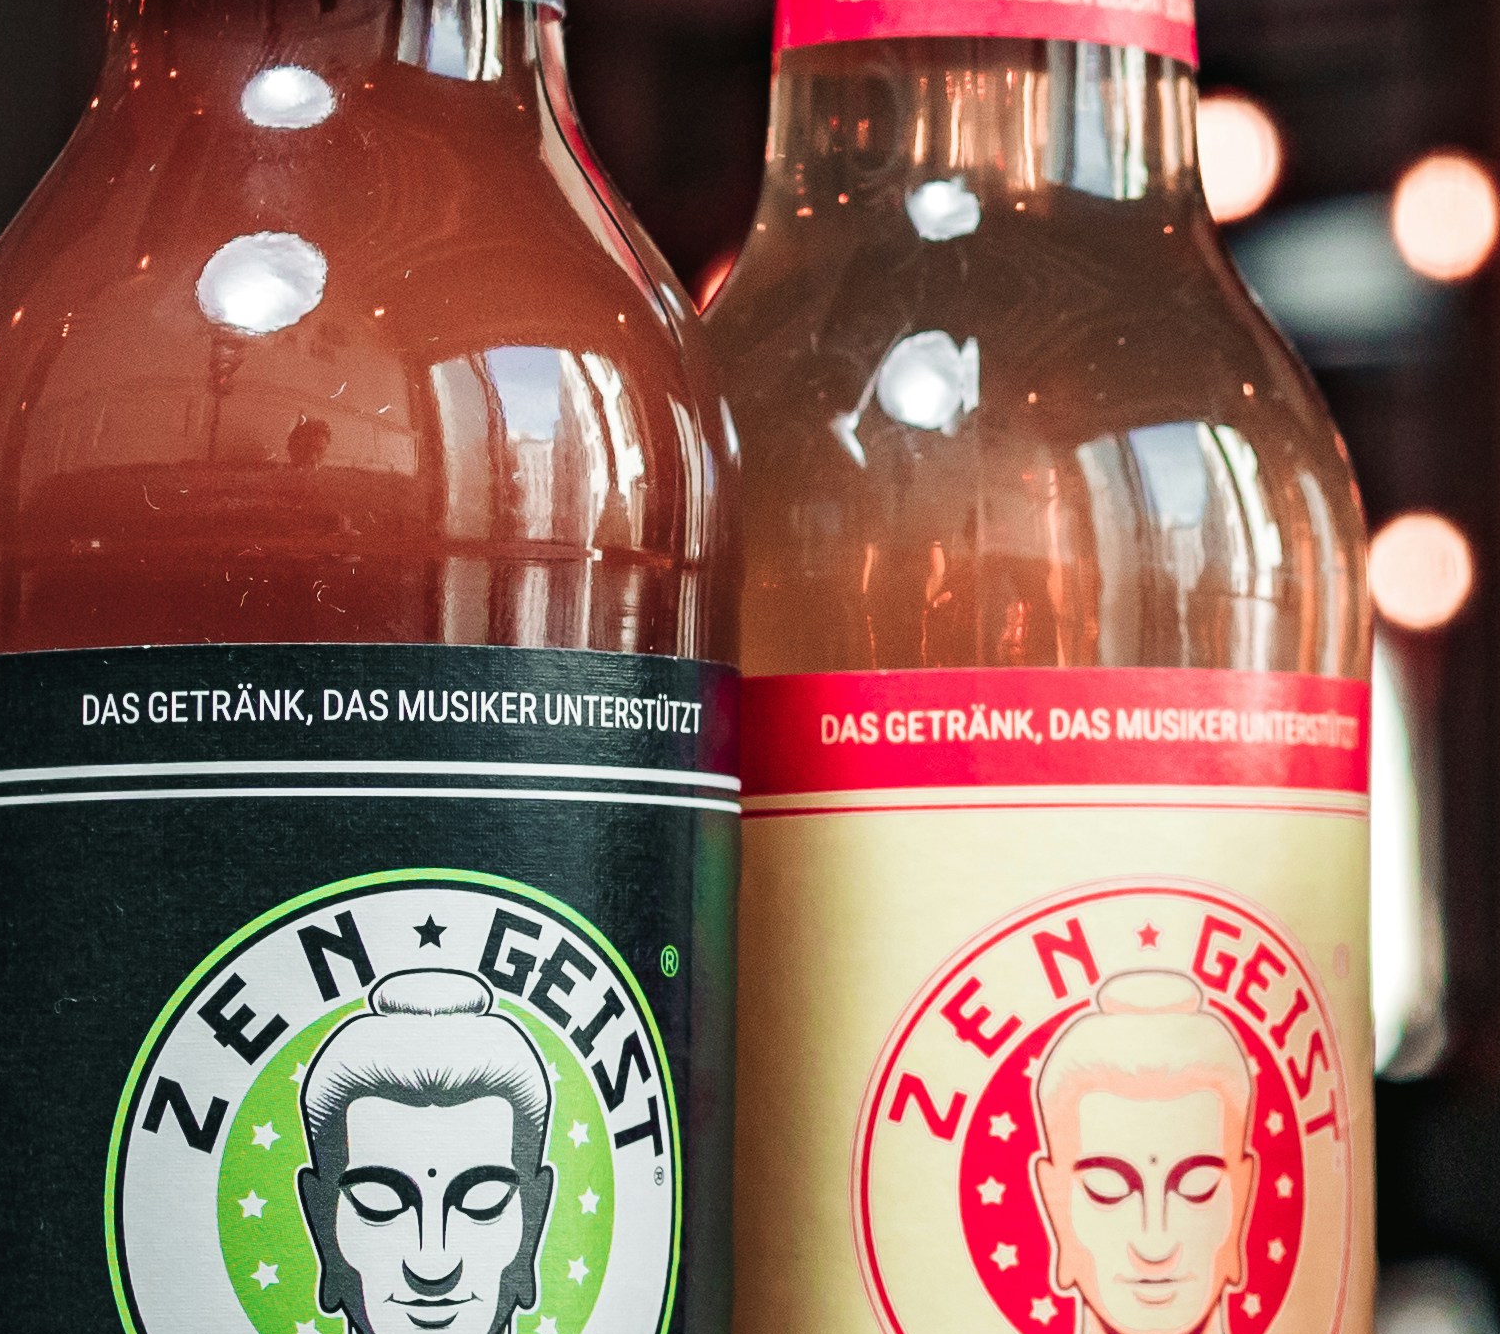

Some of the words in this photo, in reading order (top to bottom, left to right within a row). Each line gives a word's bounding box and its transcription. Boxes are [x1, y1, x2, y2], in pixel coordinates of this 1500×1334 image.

[82, 693, 140, 727] DAS
[147, 683, 314, 727] GETRÄNK,
[322, 688, 389, 723] DAS
[397, 690, 539, 726] MUSIKER
[544, 690, 703, 735] UNTERSTÜTZT
[820, 713, 880, 745] DAS
[885, 703, 1043, 745] GETRÄNK,
[1049, 708, 1111, 742] DAS
[1116, 709, 1238, 743] MUSIKER
[141, 909, 378, 1155] ZEN
[477, 907, 664, 1157] GEIST
[886, 916, 1102, 1143] ZEN
[1190, 913, 1340, 1142] GEIST
